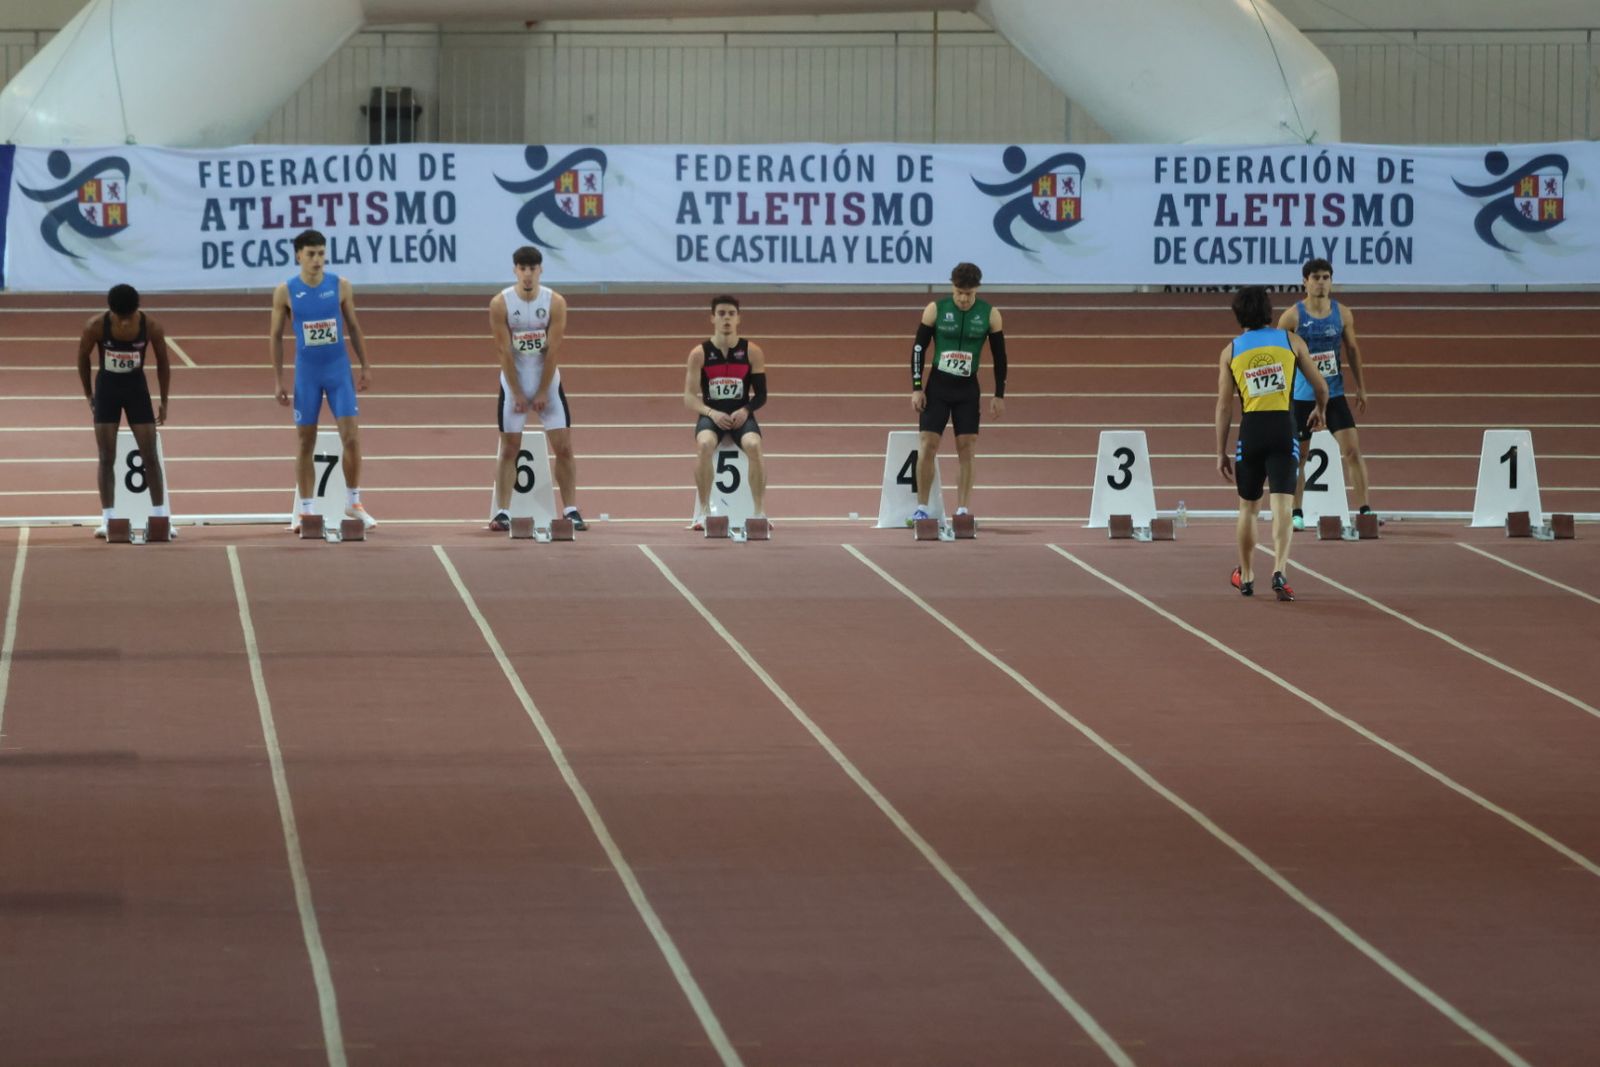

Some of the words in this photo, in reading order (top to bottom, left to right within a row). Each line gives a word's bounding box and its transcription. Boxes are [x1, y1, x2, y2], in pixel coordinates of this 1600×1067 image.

[198, 147, 397, 188] FEDERACIÓN
[419, 152, 456, 181] DE
[675, 148, 874, 182] FEDERACIÓN
[896, 154, 934, 183] DE
[1154, 149, 1355, 184] FEDERACIÓN
[1377, 157, 1414, 184] DE
[200, 191, 456, 231] ATLETISMO
[675, 191, 934, 226] ATLETISMO
[1153, 193, 1414, 228] ATLETISMO
[201, 241, 235, 270] DE
[366, 235, 383, 263] Y
[390, 228, 456, 263] LEÓN
[676, 234, 709, 263] DE
[715, 235, 836, 263] CASTILLA
[842, 236, 859, 263] Y
[866, 230, 933, 264] LEÓN
[1154, 237, 1187, 264] DE
[1193, 237, 1315, 265] CASTILLA
[1321, 237, 1339, 264] Y
[1345, 231, 1413, 265] LEÓN
[310, 328, 333, 340] 224
[519, 338, 542, 351] 255
[111, 358, 135, 369] 168
[946, 359, 967, 370] 192
[716, 384, 738, 396] 167
[1253, 373, 1280, 390] 172
[124, 449, 148, 494] 8
[313, 454, 339, 497] 7
[513, 449, 535, 494] 6
[715, 450, 741, 494] 5
[896, 449, 919, 493] 4
[1106, 446, 1136, 490] 3
[1304, 448, 1329, 492] 2
[1499, 445, 1518, 489] 1
